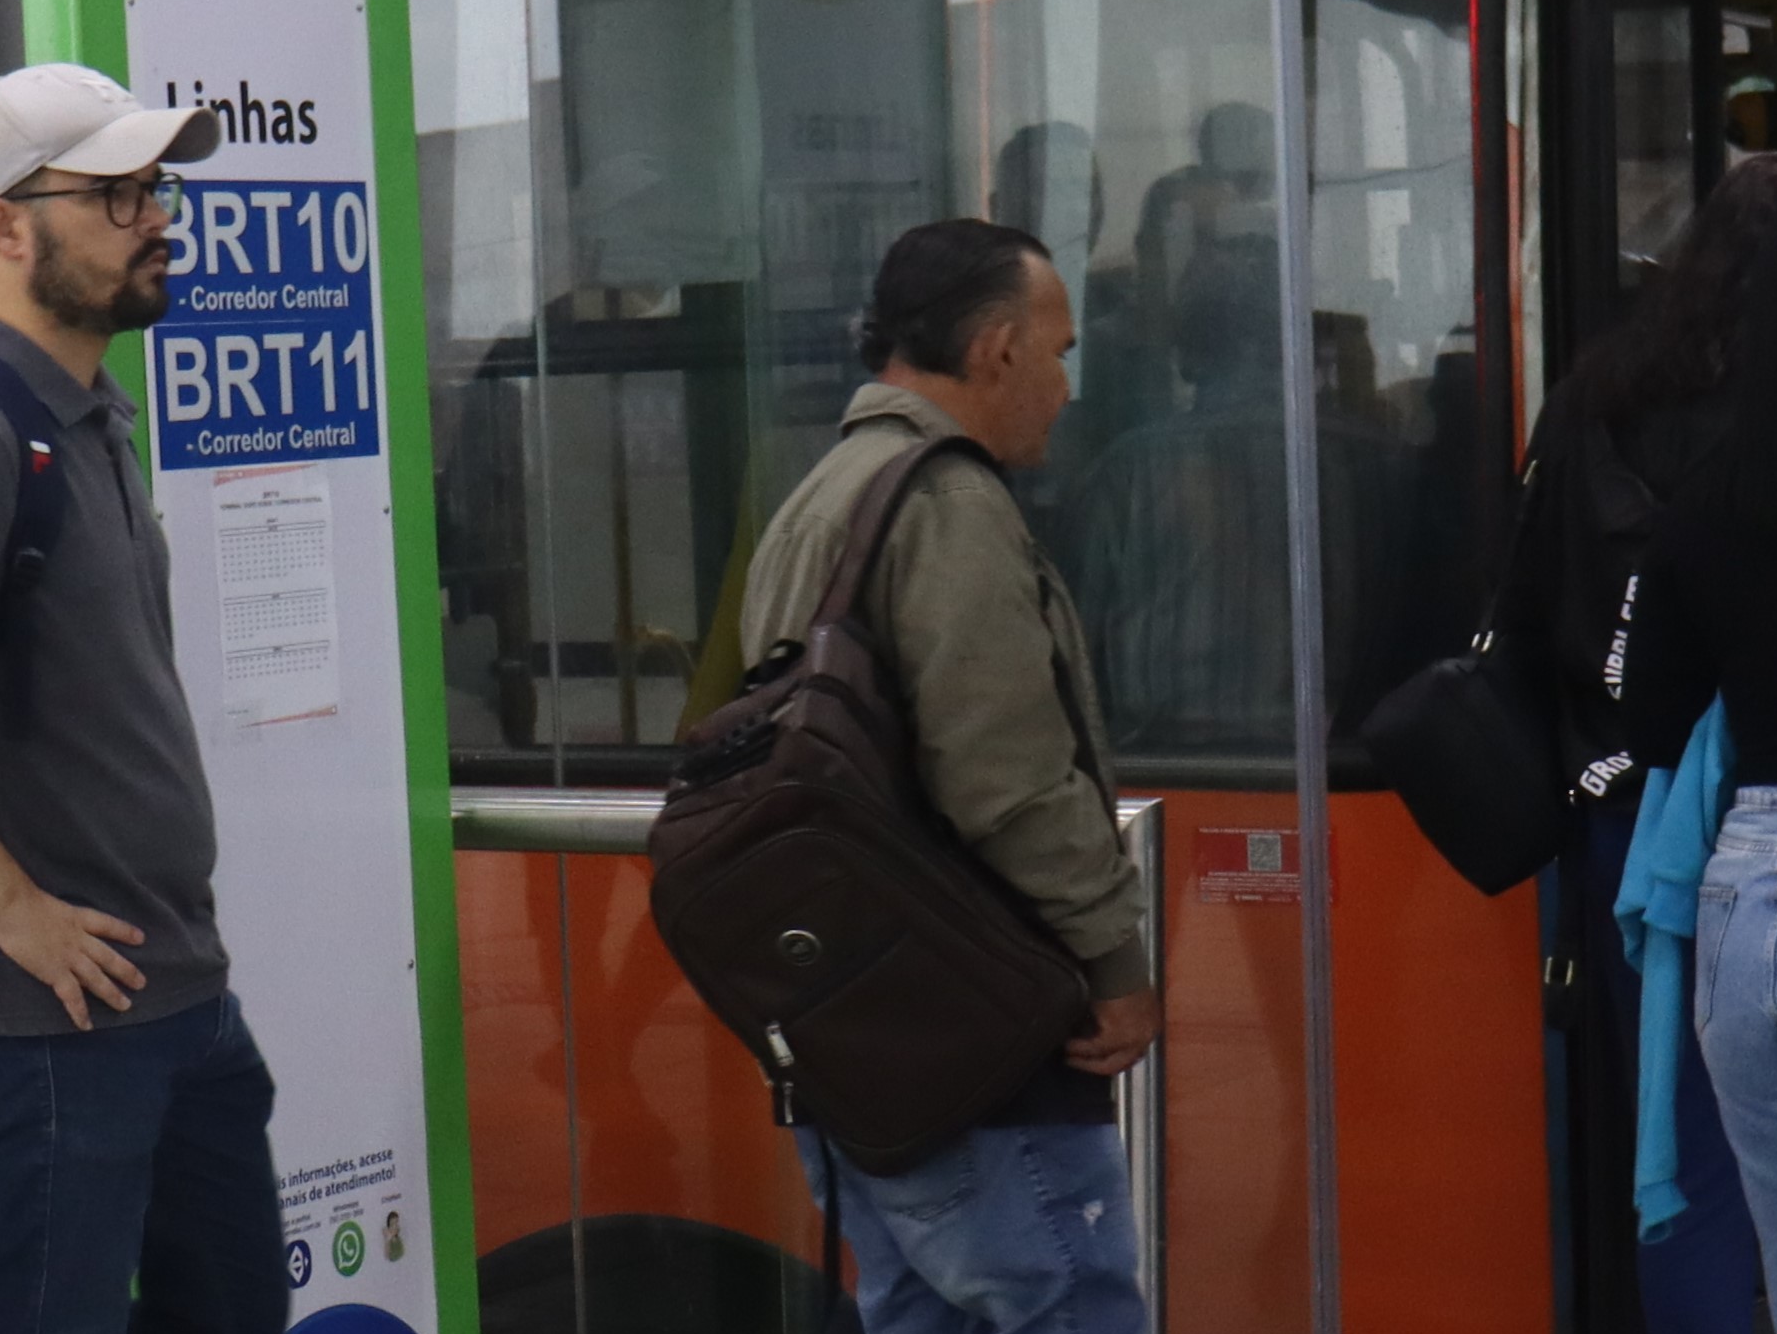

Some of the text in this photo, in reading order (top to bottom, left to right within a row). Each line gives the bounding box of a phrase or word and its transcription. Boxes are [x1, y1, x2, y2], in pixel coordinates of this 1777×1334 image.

[167, 191, 368, 275] BRT10
[191, 286, 277, 311] Corredor
[282, 284, 349, 309] Central
[163, 330, 370, 422] BRT11
[198, 428, 283, 455] Corredor
[288, 422, 356, 449] Central
[279, 1164, 396, 1210] anais de atendimento!
[288, 1159, 357, 1188] informações,
[359, 1149, 393, 1168] acesse
